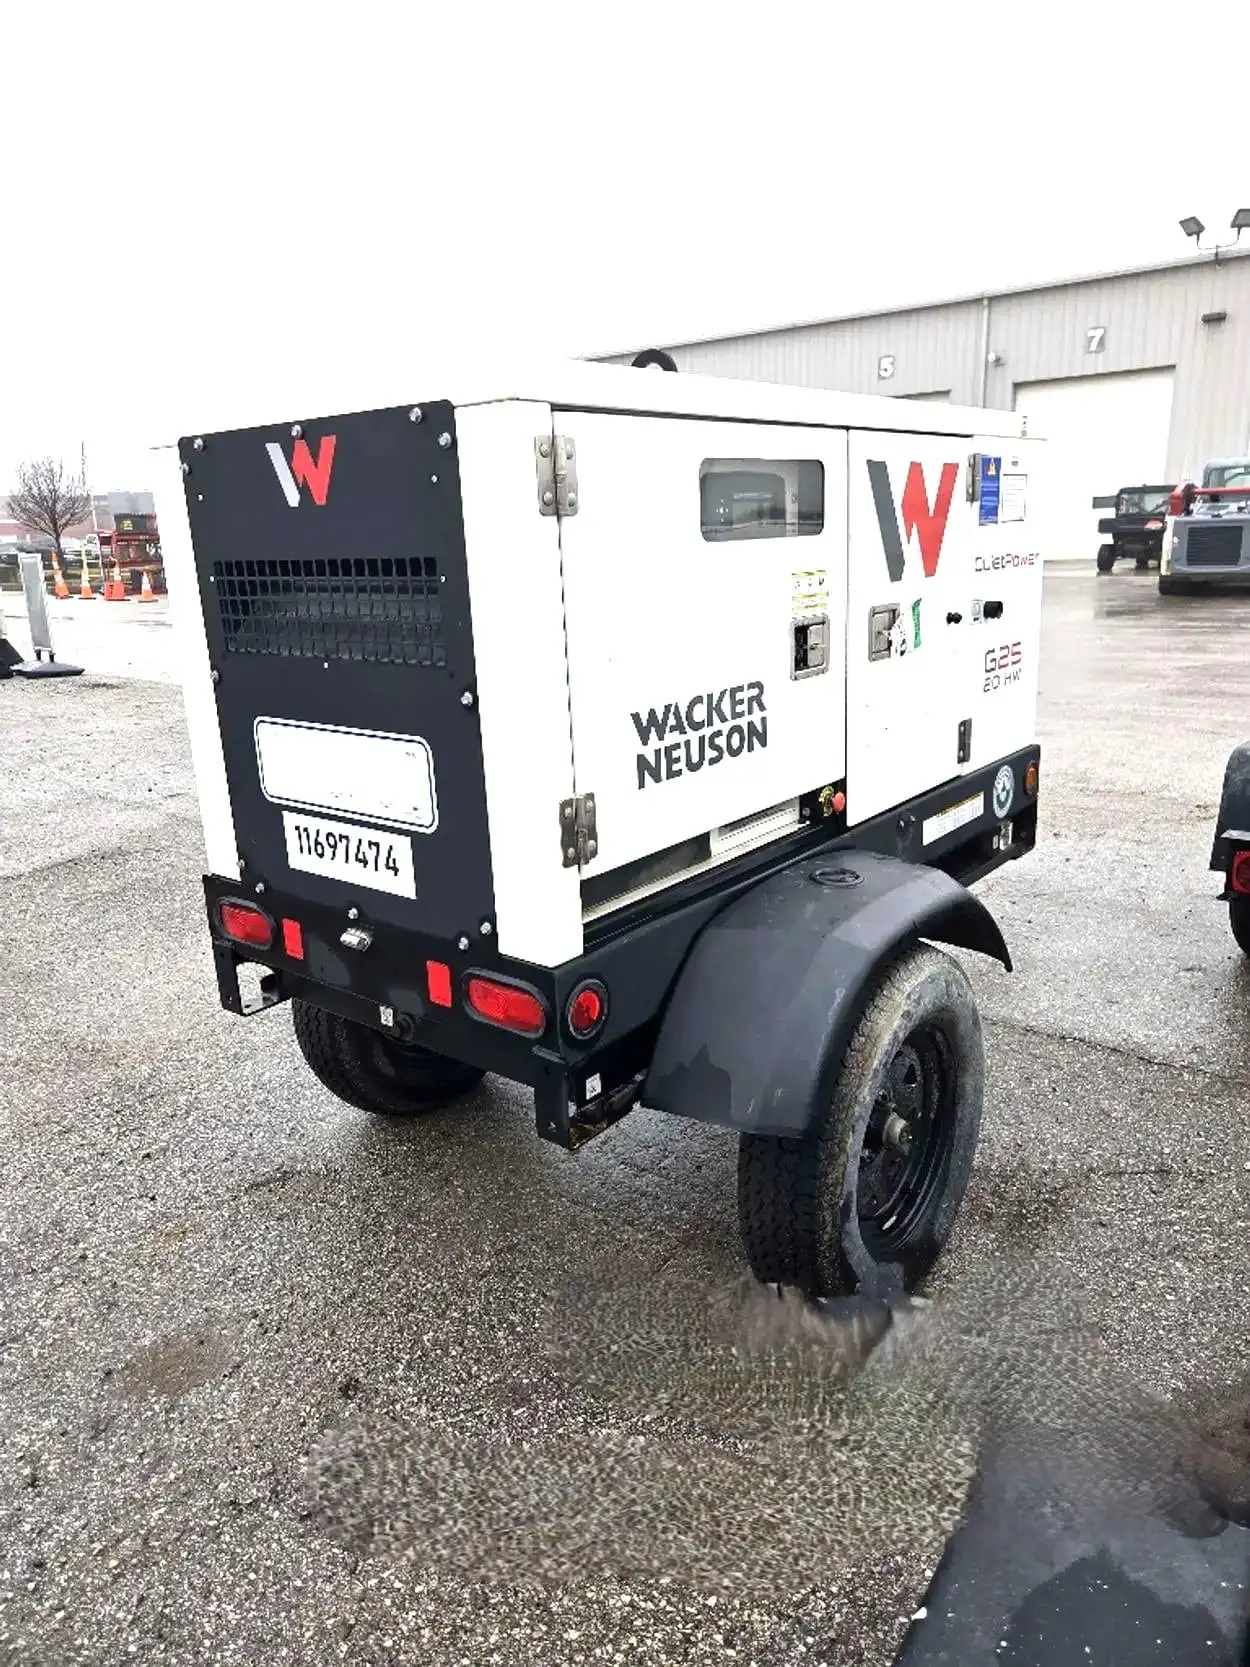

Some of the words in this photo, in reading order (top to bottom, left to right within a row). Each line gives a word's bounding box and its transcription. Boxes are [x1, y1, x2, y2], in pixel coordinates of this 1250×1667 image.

[1088, 328, 1104, 351] 7
[879, 357, 894, 377] 5
[984, 641, 1022, 674] G25
[629, 680, 768, 747] WACKER
[636, 716, 768, 790] NEUSON
[294, 825, 400, 877] 11697474
